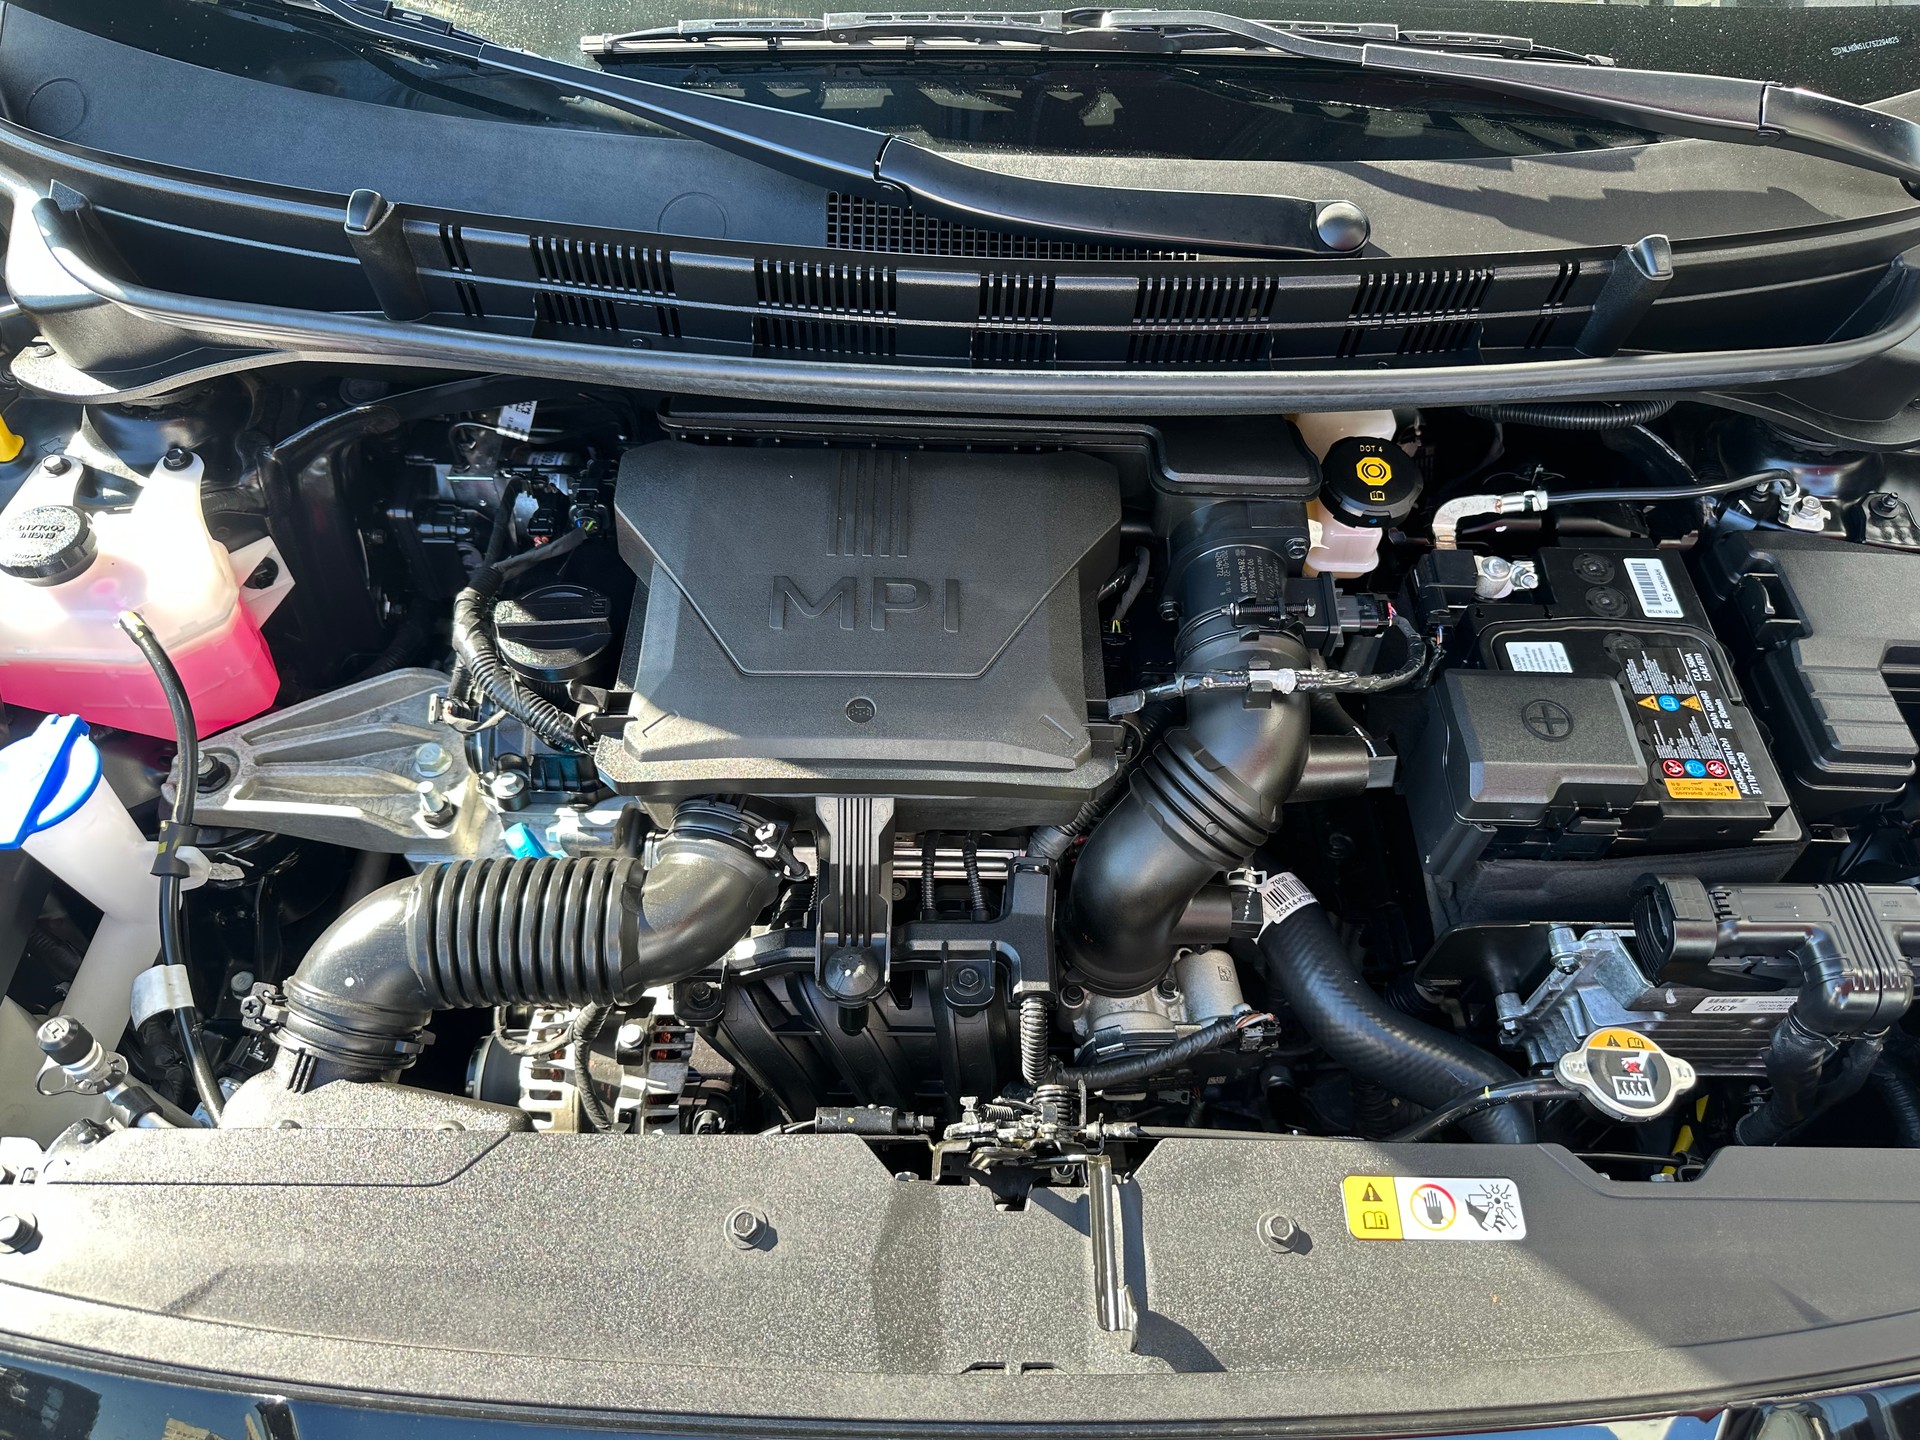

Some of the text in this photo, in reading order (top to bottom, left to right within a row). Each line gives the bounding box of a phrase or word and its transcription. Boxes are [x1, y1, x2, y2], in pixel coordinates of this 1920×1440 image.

[769, 575, 960, 632] MPI
[1662, 593, 1673, 602] G5
[1685, 653, 1702, 681] CCA 560A
[1694, 653, 1712, 681] (SAE/EN)
[1700, 690, 1722, 729] 50Ah (20HR)
[1715, 699, 1733, 730] RC 80min
[1736, 752, 1762, 795] 37110-K7520
[1271, 876, 1287, 887] 7000
